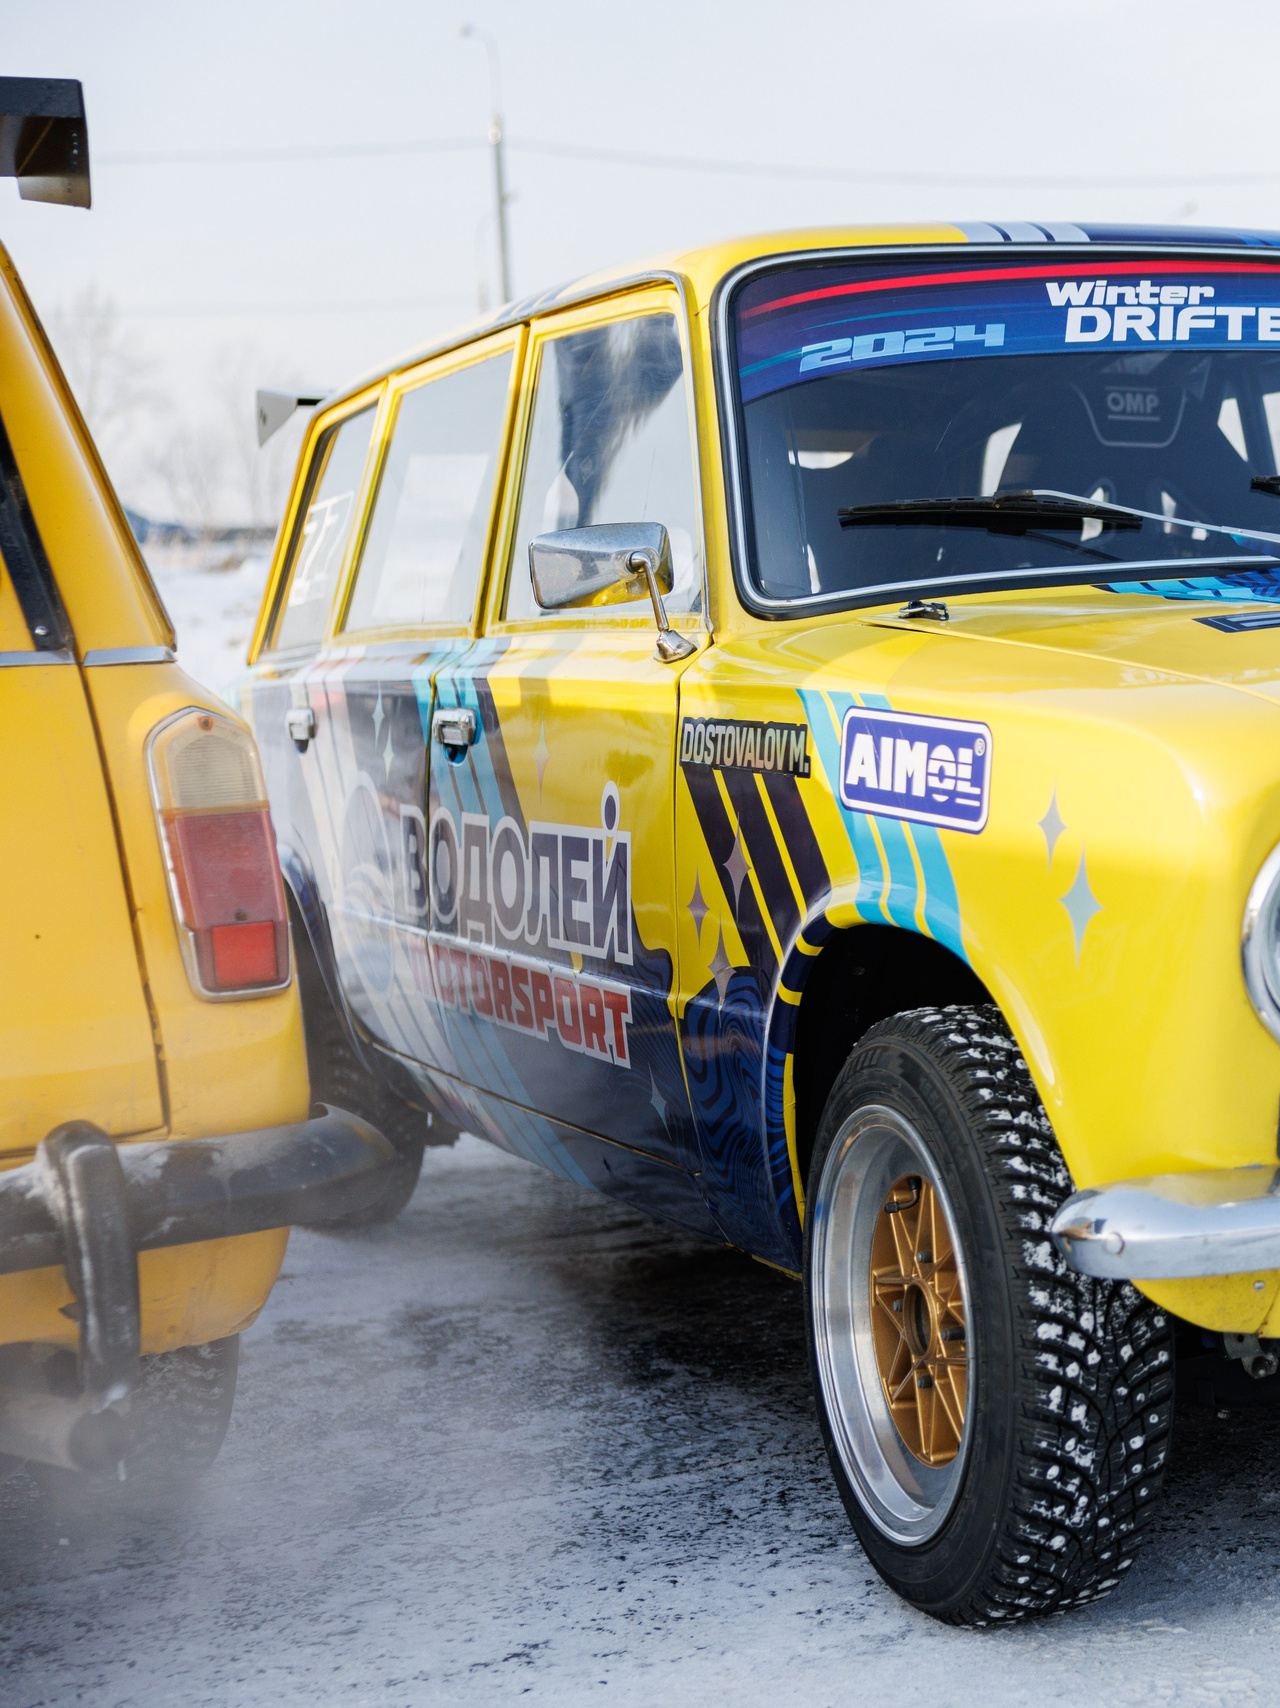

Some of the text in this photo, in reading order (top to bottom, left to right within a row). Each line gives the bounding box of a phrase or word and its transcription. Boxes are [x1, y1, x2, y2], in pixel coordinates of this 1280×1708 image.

[1046, 280, 1215, 306] Winter
[799, 323, 1006, 373] 2024
[1106, 391, 1160, 414] OMP
[681, 723, 810, 773] DOSTOVALOV M.
[400, 780, 634, 966] ВОДОЛЕЙ
[409, 935, 633, 1069] MOTORSPORT
